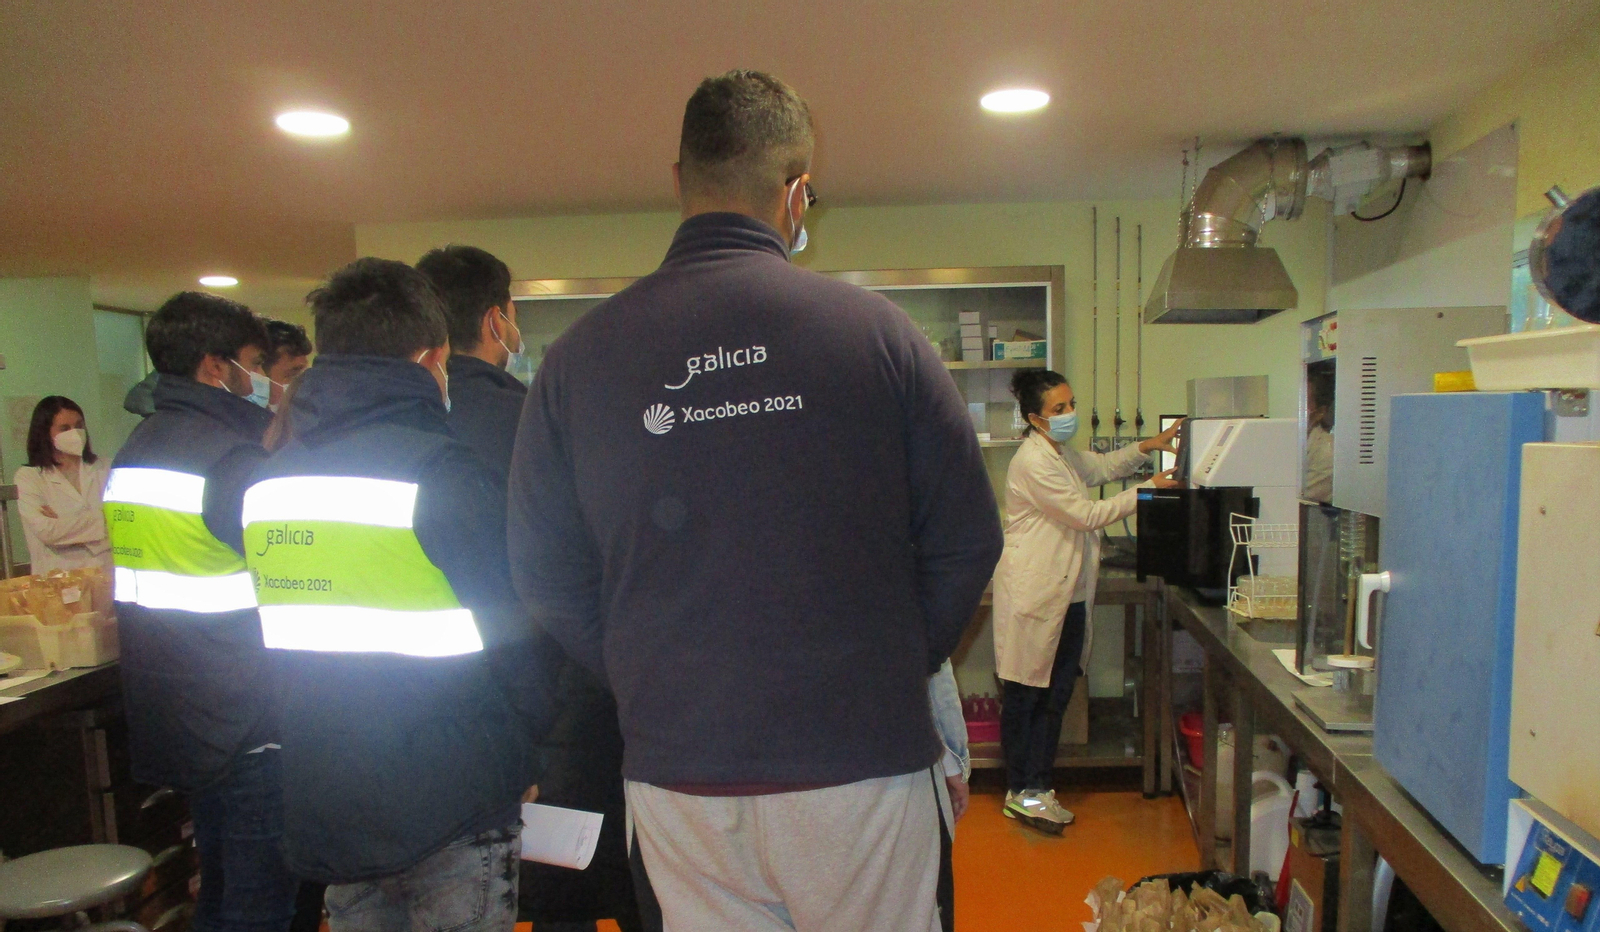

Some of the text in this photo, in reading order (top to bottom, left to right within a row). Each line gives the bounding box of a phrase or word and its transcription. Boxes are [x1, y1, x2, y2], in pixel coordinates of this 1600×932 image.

[664, 345, 768, 390] galicia
[681, 395, 803, 423] Xacobeo 2021
[256, 523, 315, 557] galicia
[263, 573, 332, 592] Xacobeo 2021
